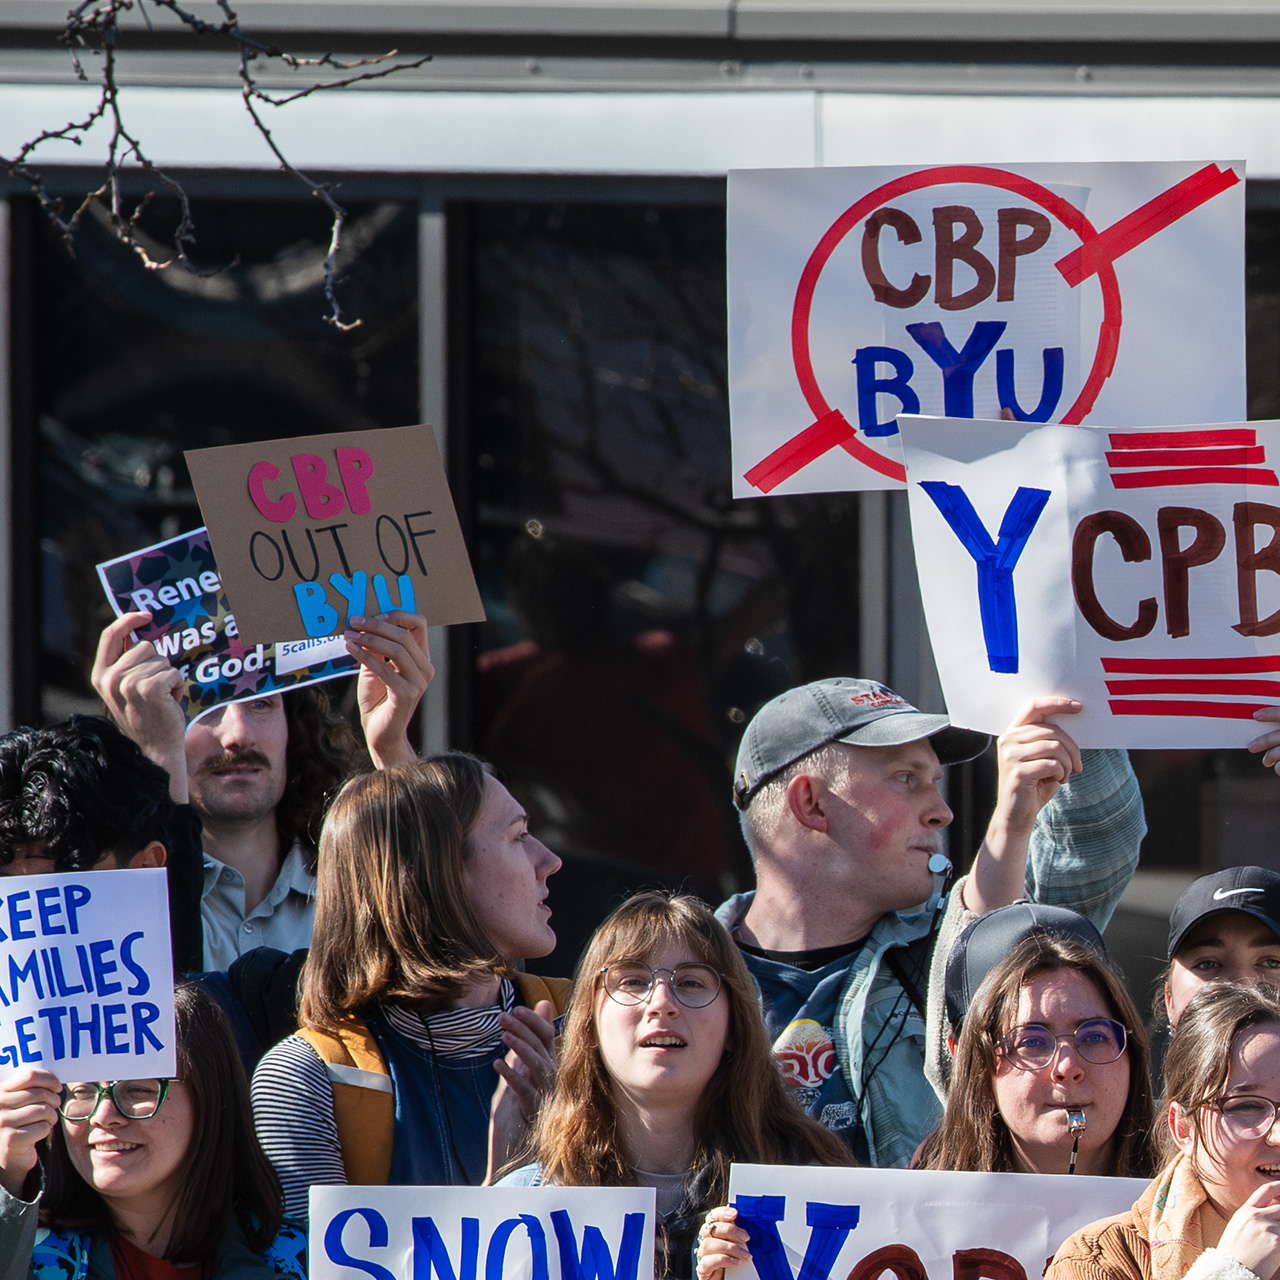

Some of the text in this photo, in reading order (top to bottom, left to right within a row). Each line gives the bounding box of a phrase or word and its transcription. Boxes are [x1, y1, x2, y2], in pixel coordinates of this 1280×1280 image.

[861, 205, 1052, 312] CBP
[851, 321, 1064, 438] BYU
[248, 447, 375, 523] CBP
[250, 511, 436, 582] OUT OF
[131, 569, 223, 612] Rene
[293, 570, 416, 637] BYU
[195, 643, 271, 684] God.
